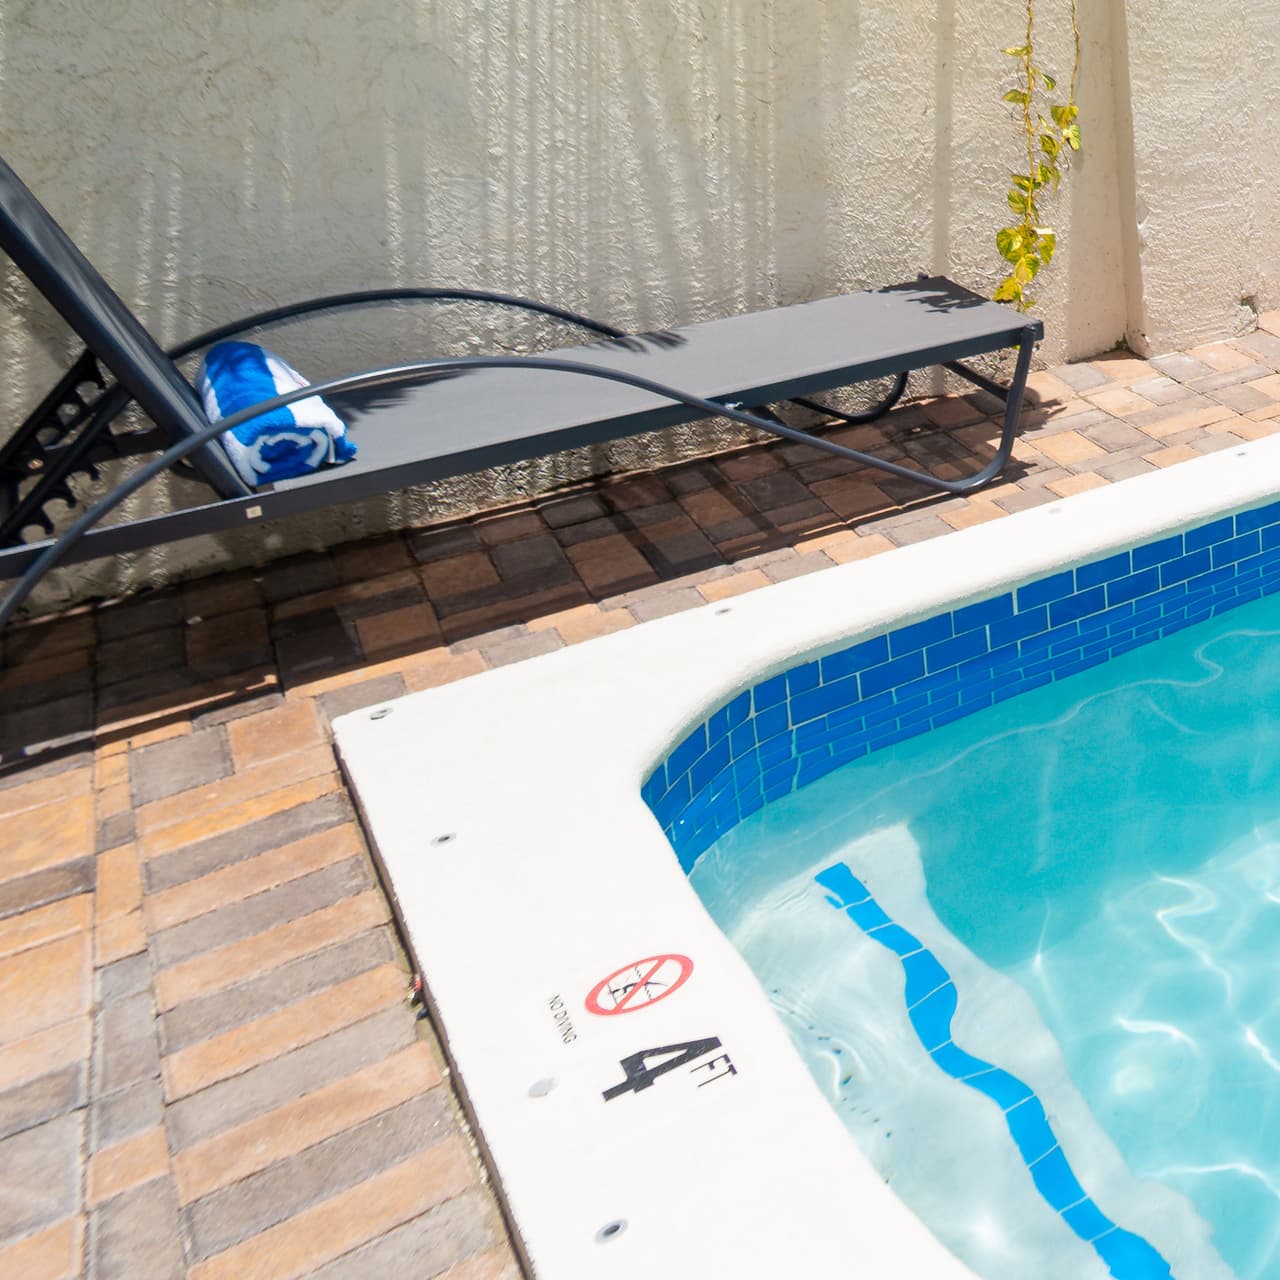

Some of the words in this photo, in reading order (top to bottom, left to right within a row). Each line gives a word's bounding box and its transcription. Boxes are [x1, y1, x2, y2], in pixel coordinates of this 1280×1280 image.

[548, 994, 564, 1013] NO
[553, 1009, 578, 1045] DIVING
[602, 1036, 722, 1103] 4
[690, 1054, 738, 1088] FT
